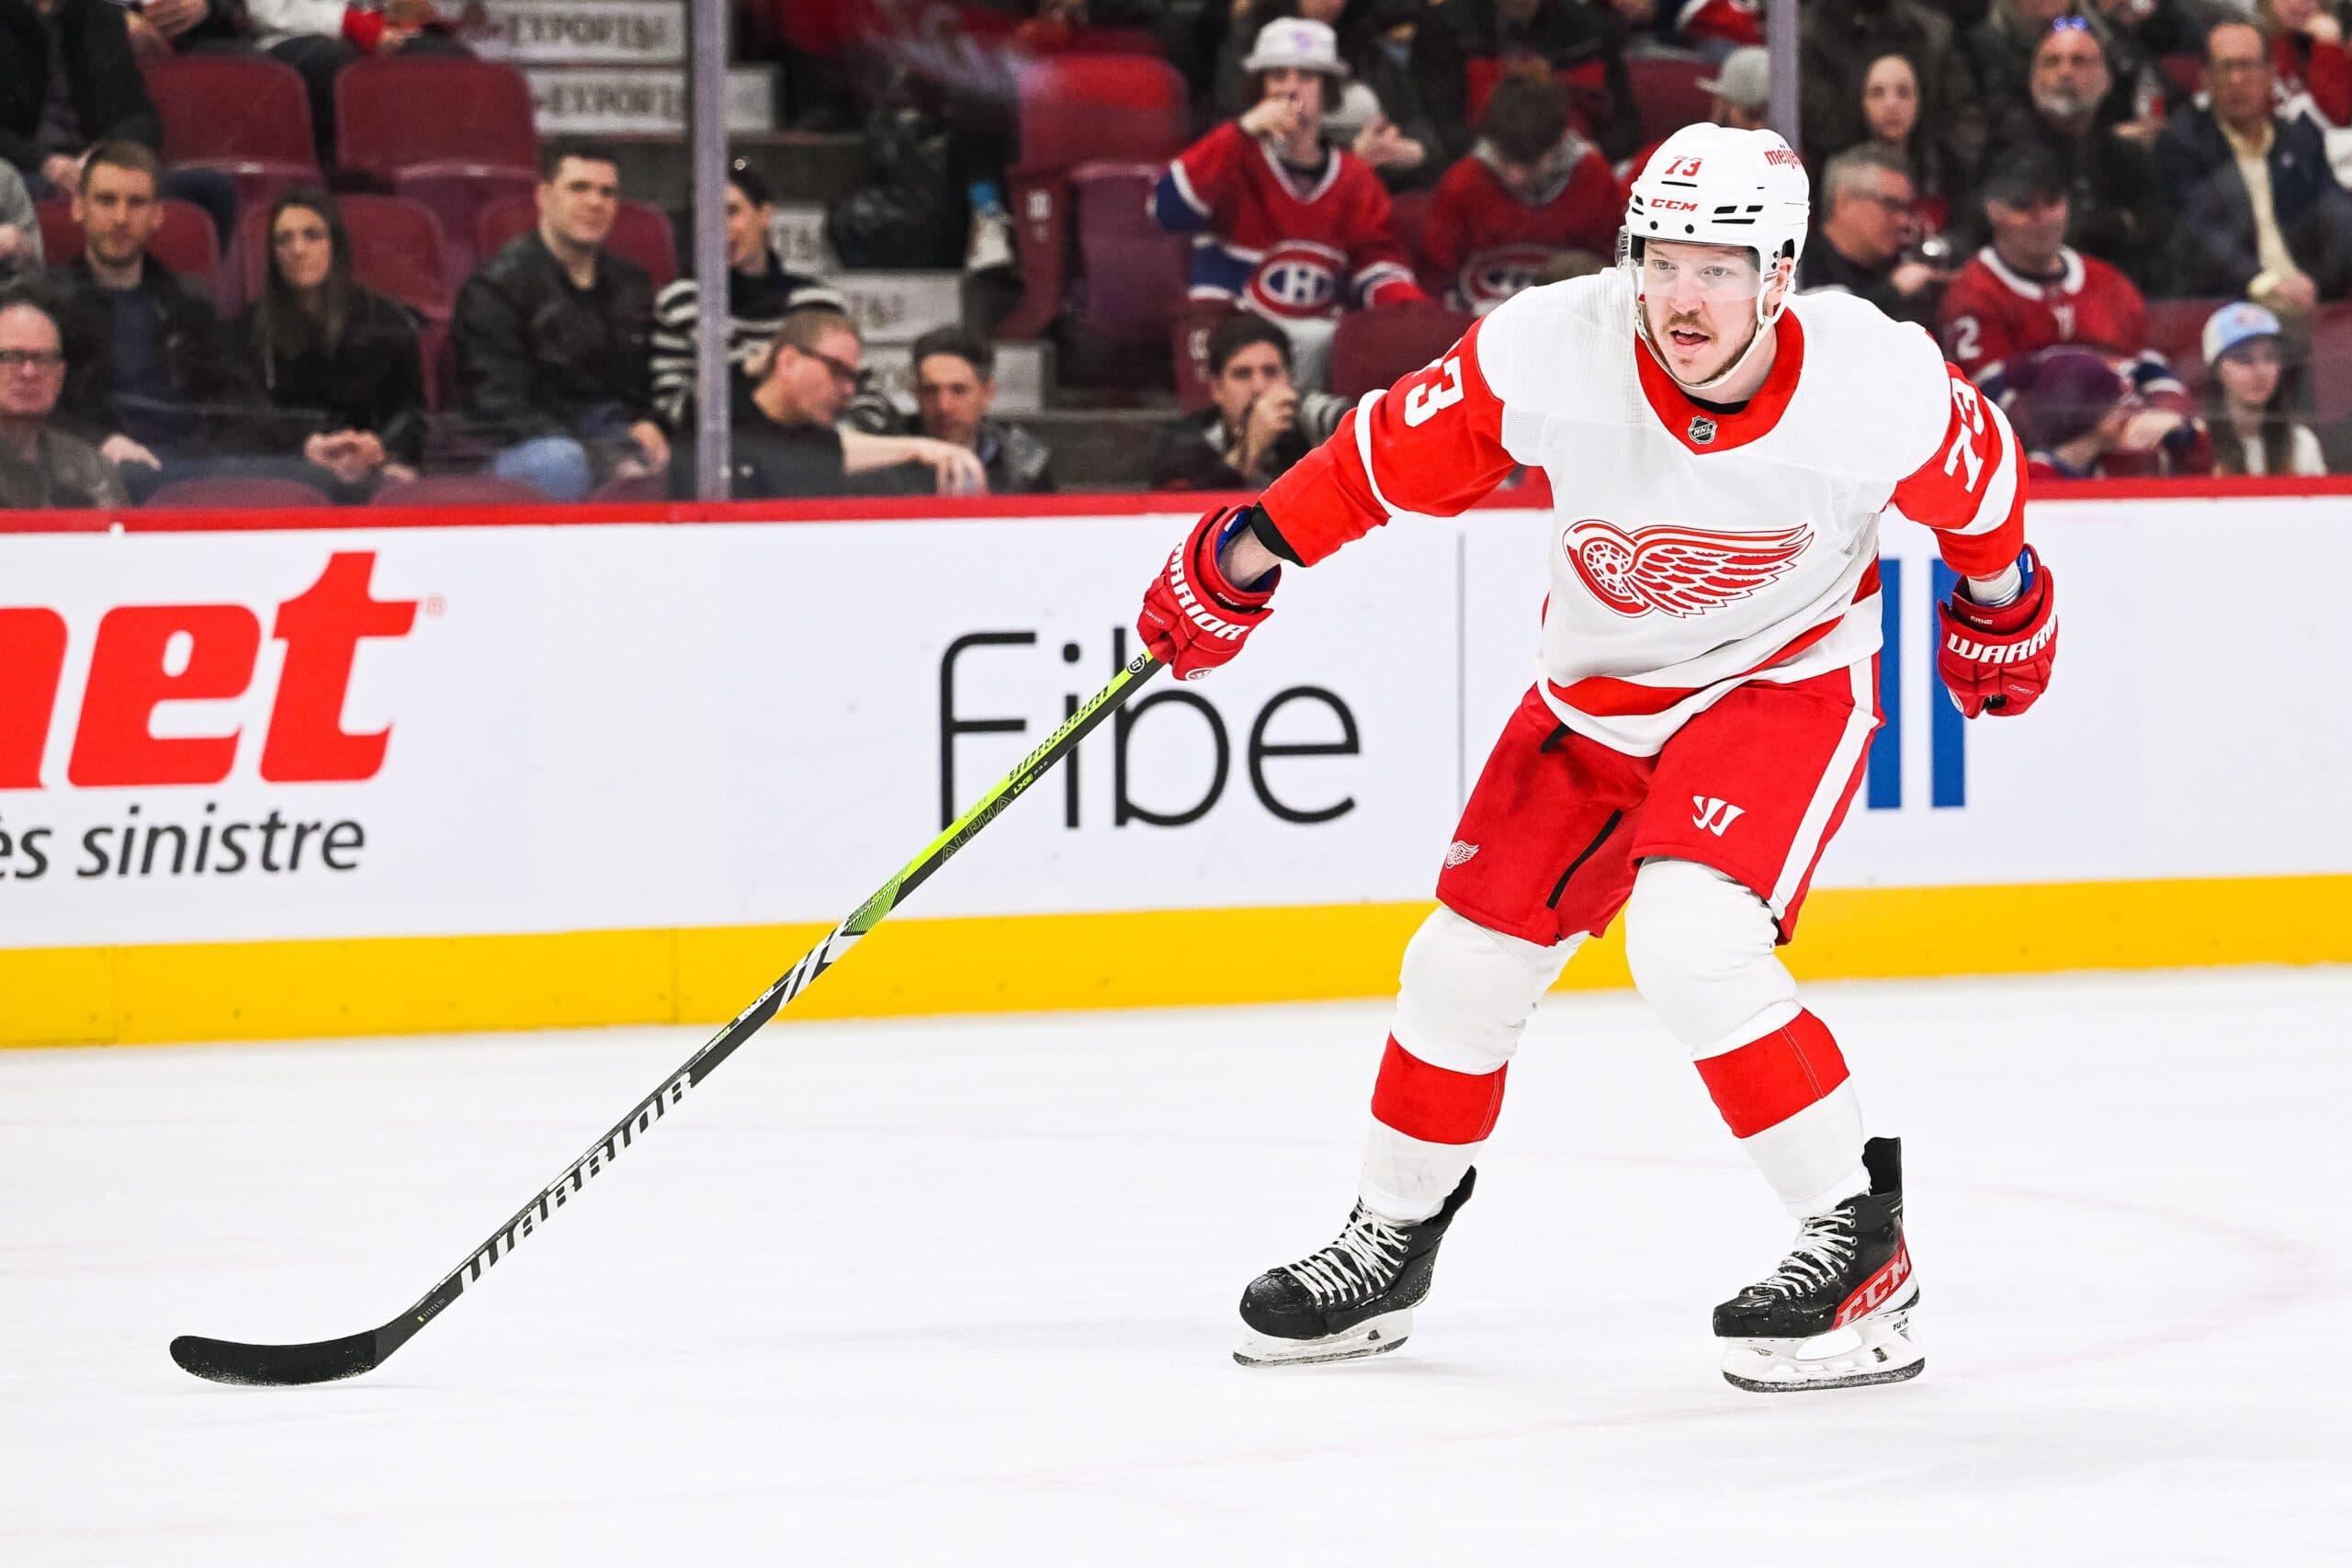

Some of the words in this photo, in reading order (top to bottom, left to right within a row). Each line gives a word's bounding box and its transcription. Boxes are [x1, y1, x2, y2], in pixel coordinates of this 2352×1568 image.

[1665, 155, 1702, 177] 73
[1650, 198, 1699, 212] CCM
[1693, 424, 1713, 437] NHL
[1943, 377, 1985, 493] 73
[1170, 540, 1250, 641] ARRIOR
[939, 626, 1362, 829] Fibe
[76, 802, 366, 878] sinistre
[942, 795, 1013, 865] ALPHA
[460, 1071, 692, 1292] WARRIOR
[1838, 1248, 1909, 1325] CCM
